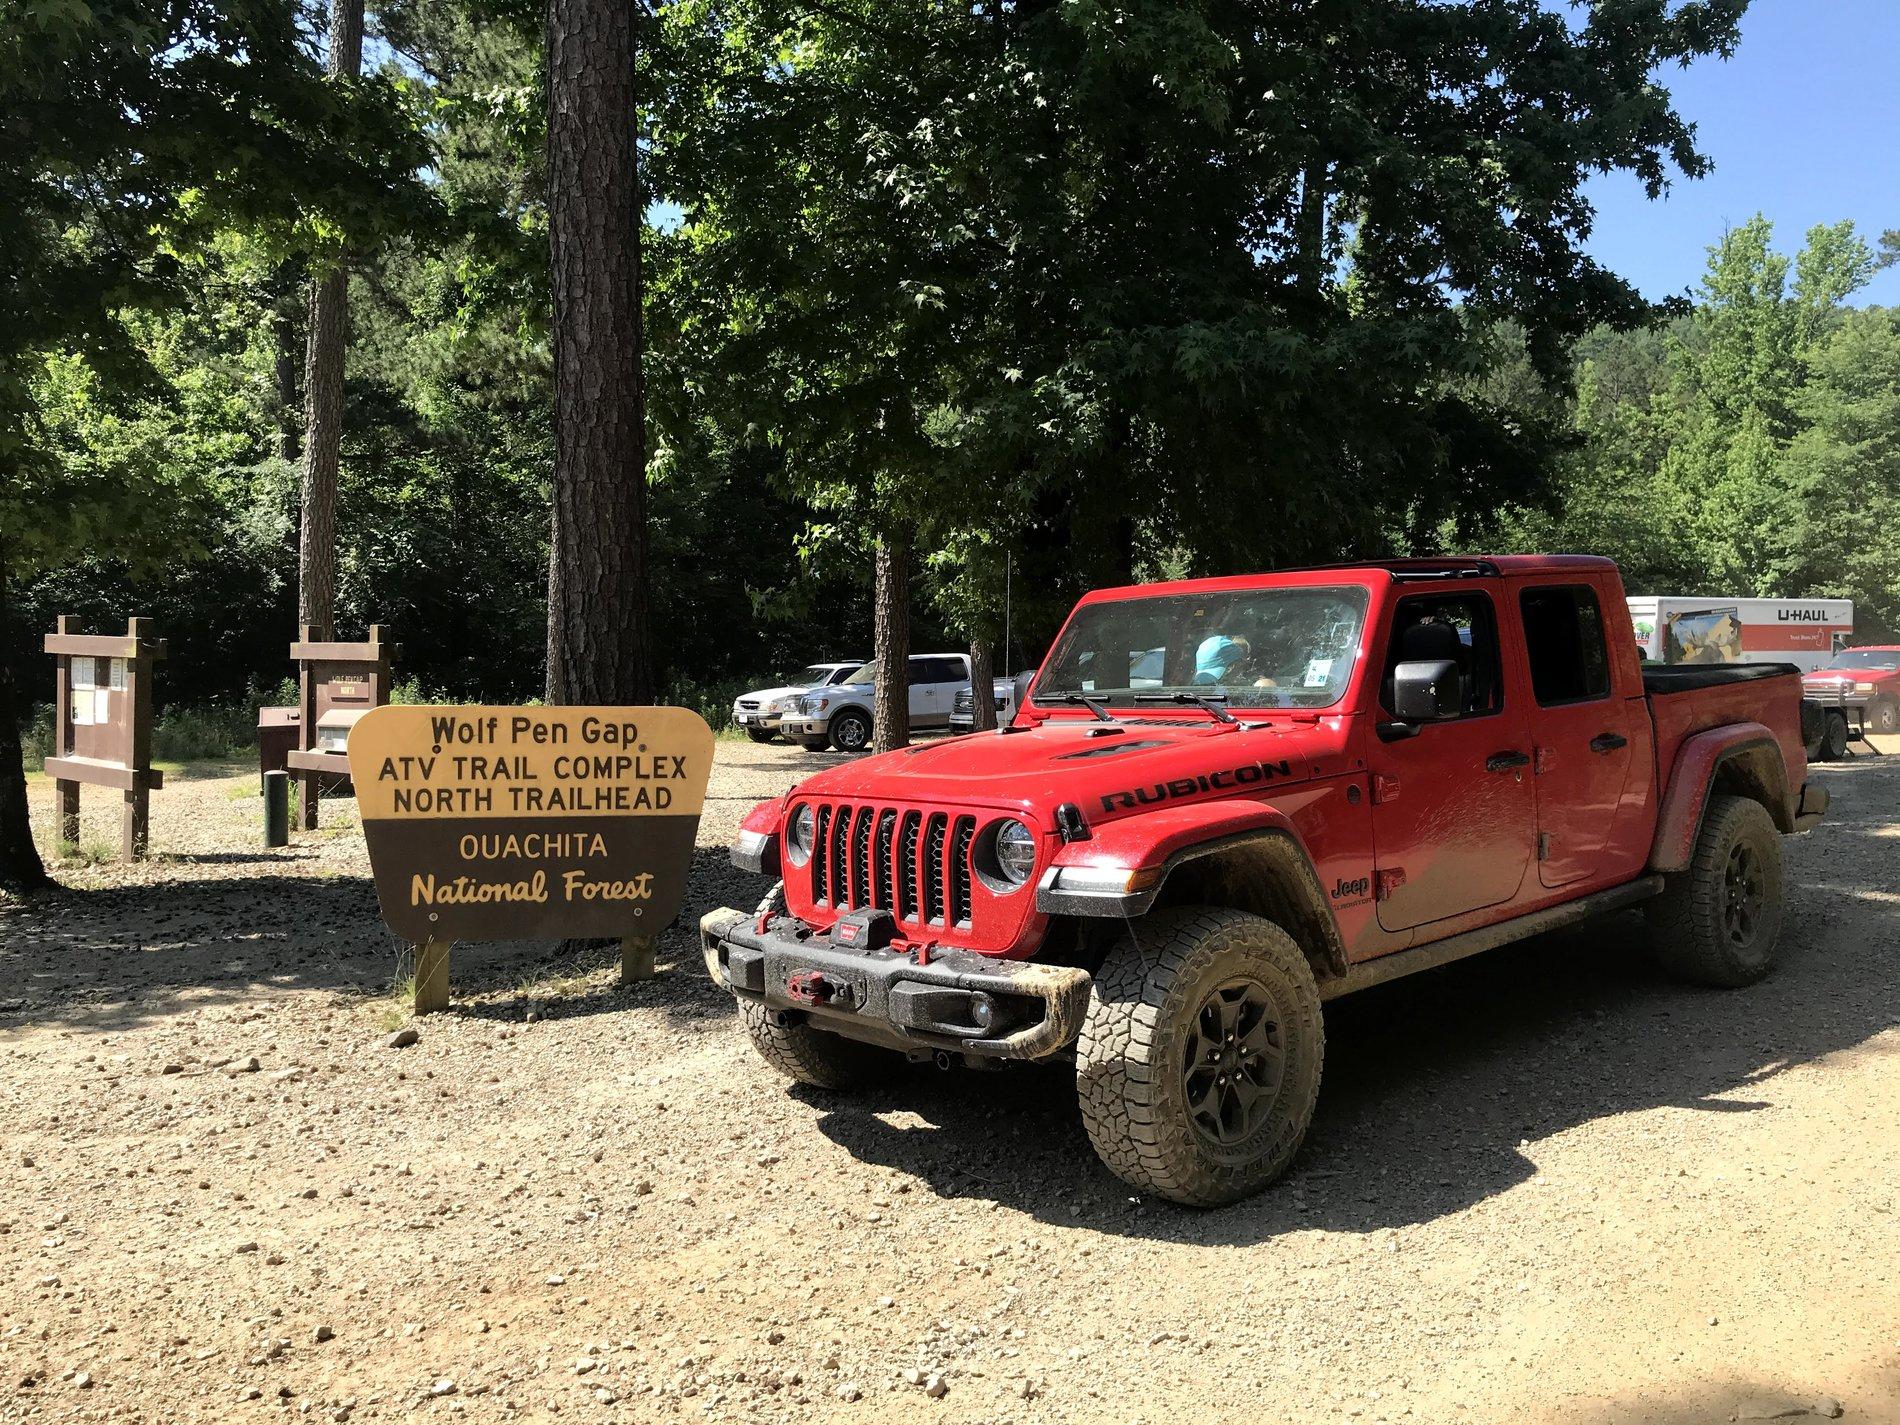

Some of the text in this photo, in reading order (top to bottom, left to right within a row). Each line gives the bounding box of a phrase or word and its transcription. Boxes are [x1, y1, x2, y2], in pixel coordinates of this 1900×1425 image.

[1778, 609, 1829, 621] U-HAUL
[432, 716, 638, 749] Wolf Pen Gap
[378, 756, 687, 781] ATV TRAIL COMPLEX
[1101, 760, 1291, 812] RUBICON
[394, 787, 672, 812] NORTH TRAILHEAD
[459, 833, 608, 860] OUACHITA
[411, 869, 654, 906] National Forest
[1331, 877, 1369, 898] Jeep
